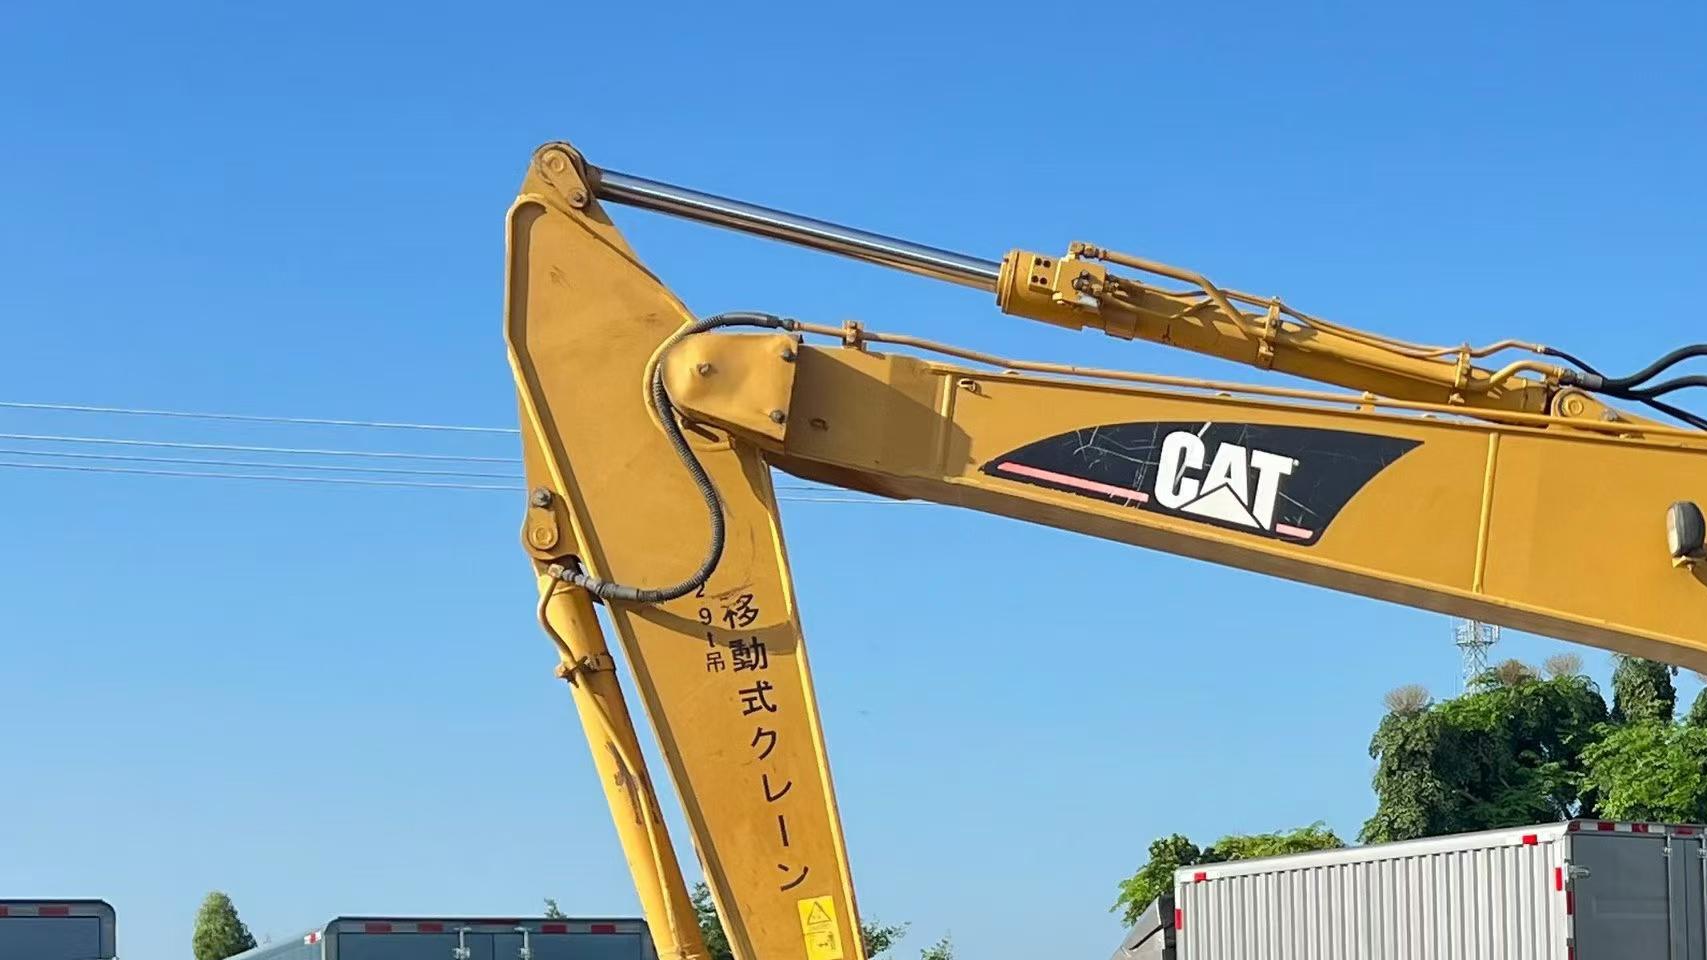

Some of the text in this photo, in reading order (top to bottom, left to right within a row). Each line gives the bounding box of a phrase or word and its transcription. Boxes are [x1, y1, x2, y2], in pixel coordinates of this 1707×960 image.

[1154, 430, 1295, 531] CAT
[720, 593, 809, 891] 移動式クレーン
